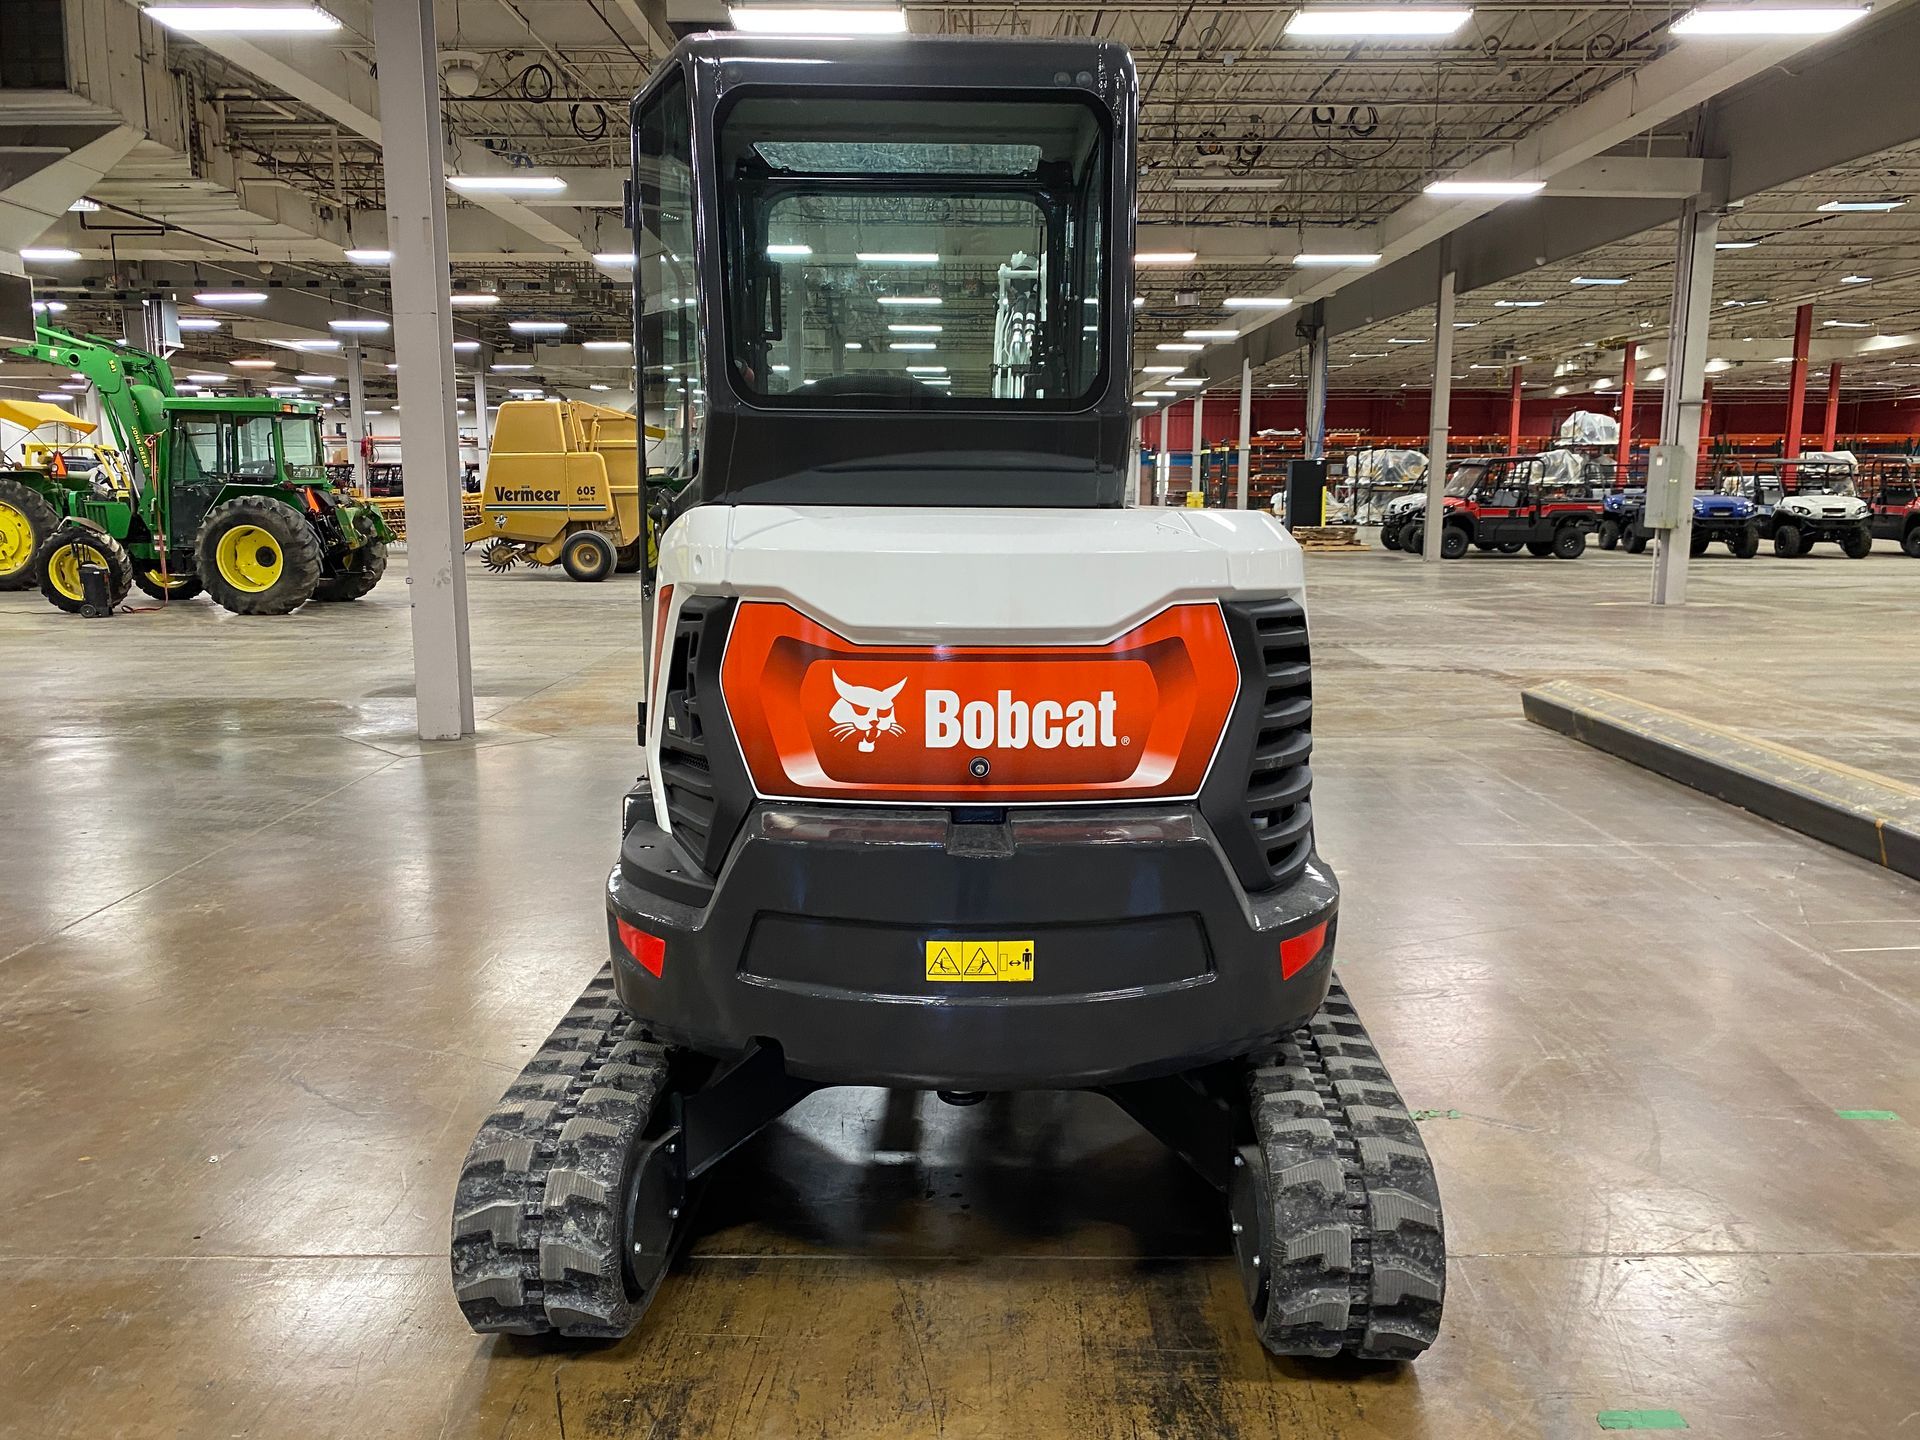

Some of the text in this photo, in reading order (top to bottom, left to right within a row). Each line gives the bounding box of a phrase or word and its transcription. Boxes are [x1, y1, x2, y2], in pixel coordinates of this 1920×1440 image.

[131, 425, 149, 468] JOHN DEERE
[494, 486, 561, 502] Vermeer
[576, 486, 596, 496] 605
[925, 689, 1117, 749] Bobcat
